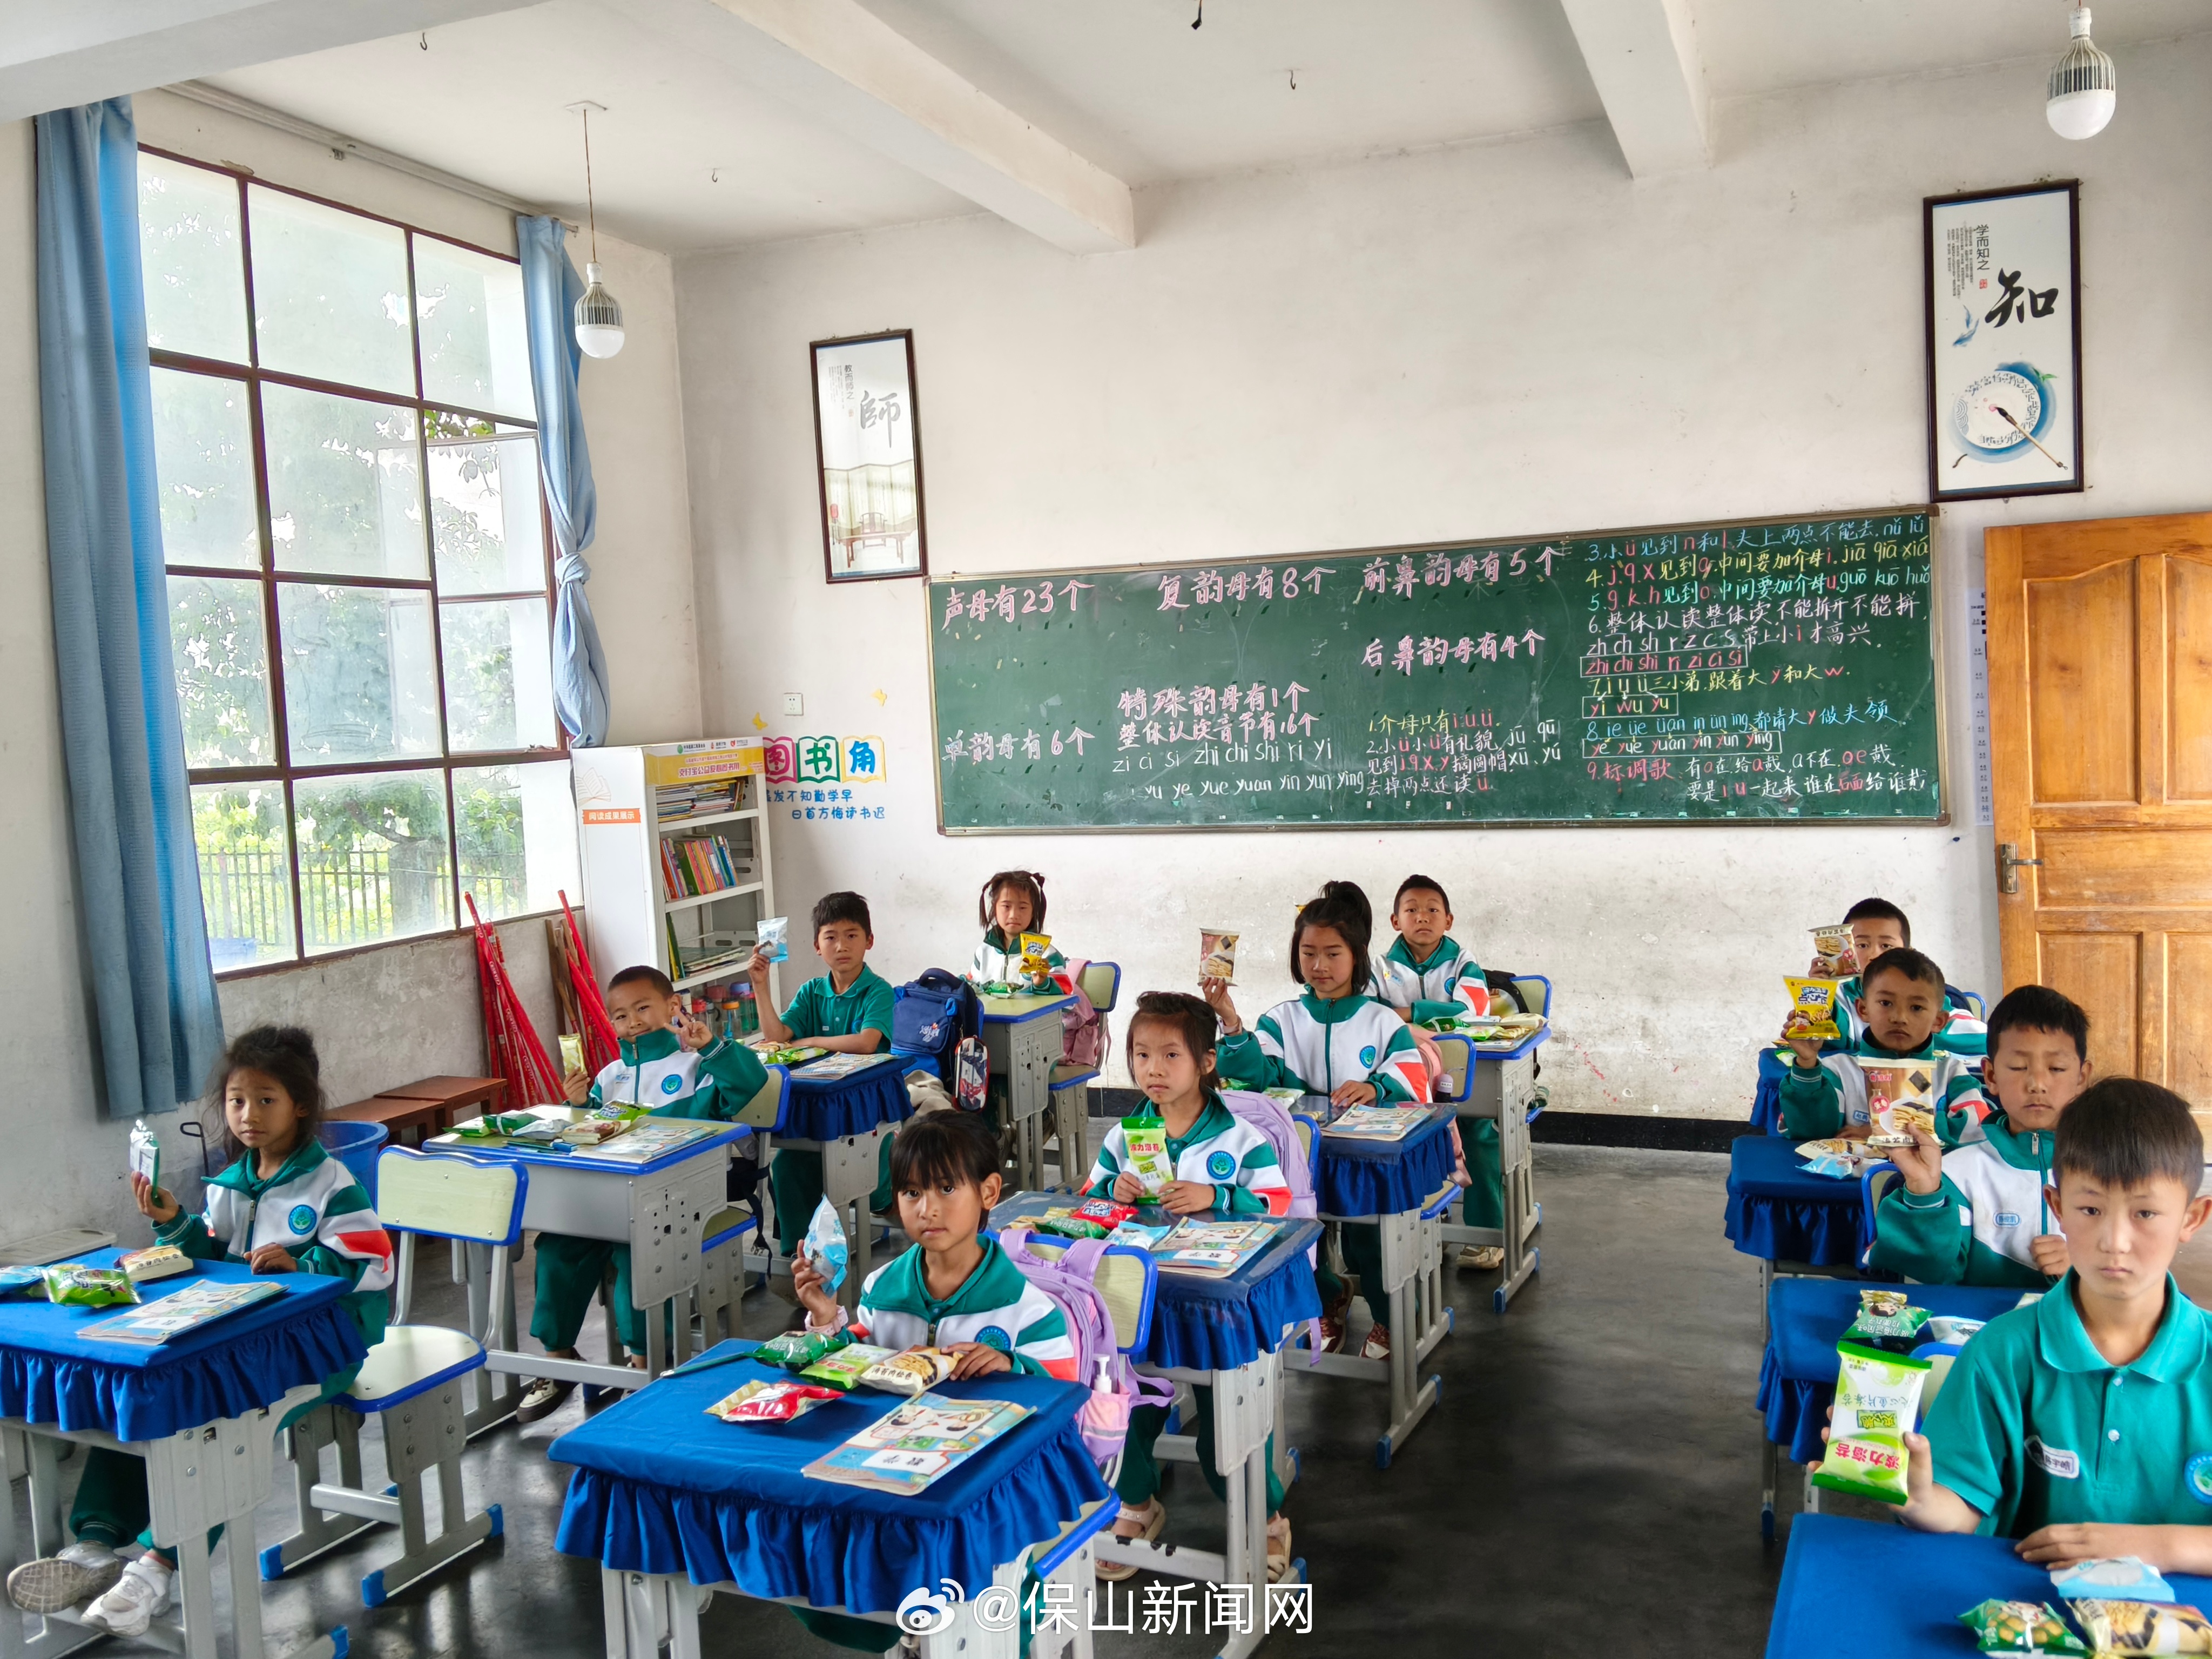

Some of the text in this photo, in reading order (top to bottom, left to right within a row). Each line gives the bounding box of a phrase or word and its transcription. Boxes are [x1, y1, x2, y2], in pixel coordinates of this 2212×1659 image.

[1976, 224, 1990, 271] 学而知之
[1985, 267, 2059, 328] 知
[844, 364, 854, 400] 教而师之
[860, 390, 901, 448] 師
[1157, 566, 1337, 611] 复韵母有8个
[1363, 547, 1566, 599] 前鼻韵母有5个
[941, 579, 1096, 631] 声母有23个
[1361, 629, 1546, 676] 后鼻韵母有4个
[1587, 638, 1607, 656] zh
[1614, 635, 1632, 654] ch
[1640, 631, 1658, 652] sh
[1669, 637, 1678, 651] r
[1585, 649, 1742, 675] zhi chi shi ri zi ci si
[1117, 681, 1310, 720] 特殊韵母有1个
[1590, 697, 1669, 717] yi wu yu
[942, 726, 1096, 763] 单韵母有6个
[1117, 711, 1319, 752] 整体认读音节有16个
[1591, 732, 1773, 757] ye yue yuan yin yun ying
[764, 740, 876, 775] 图书角
[1112, 737, 1332, 773] zi ci si zhi chi shi ri yi
[1172, 783, 1191, 799] ye
[1199, 780, 1230, 797] yue
[1233, 777, 1272, 795] yuan
[1279, 773, 1300, 792] yin
[1305, 773, 1332, 792] yun
[1336, 770, 1364, 794] ying
[589, 811, 635, 821] 阅读成果展示
[1129, 1143, 1159, 1152] 波力海苔
[1854, 1323, 1910, 1338] 波力海苔风味
[1867, 1317, 1901, 1327] 拉面丸子
[871, 1365, 913, 1381] 海苔肉松卷
[1835, 1442, 1900, 1470] 波力海苔
